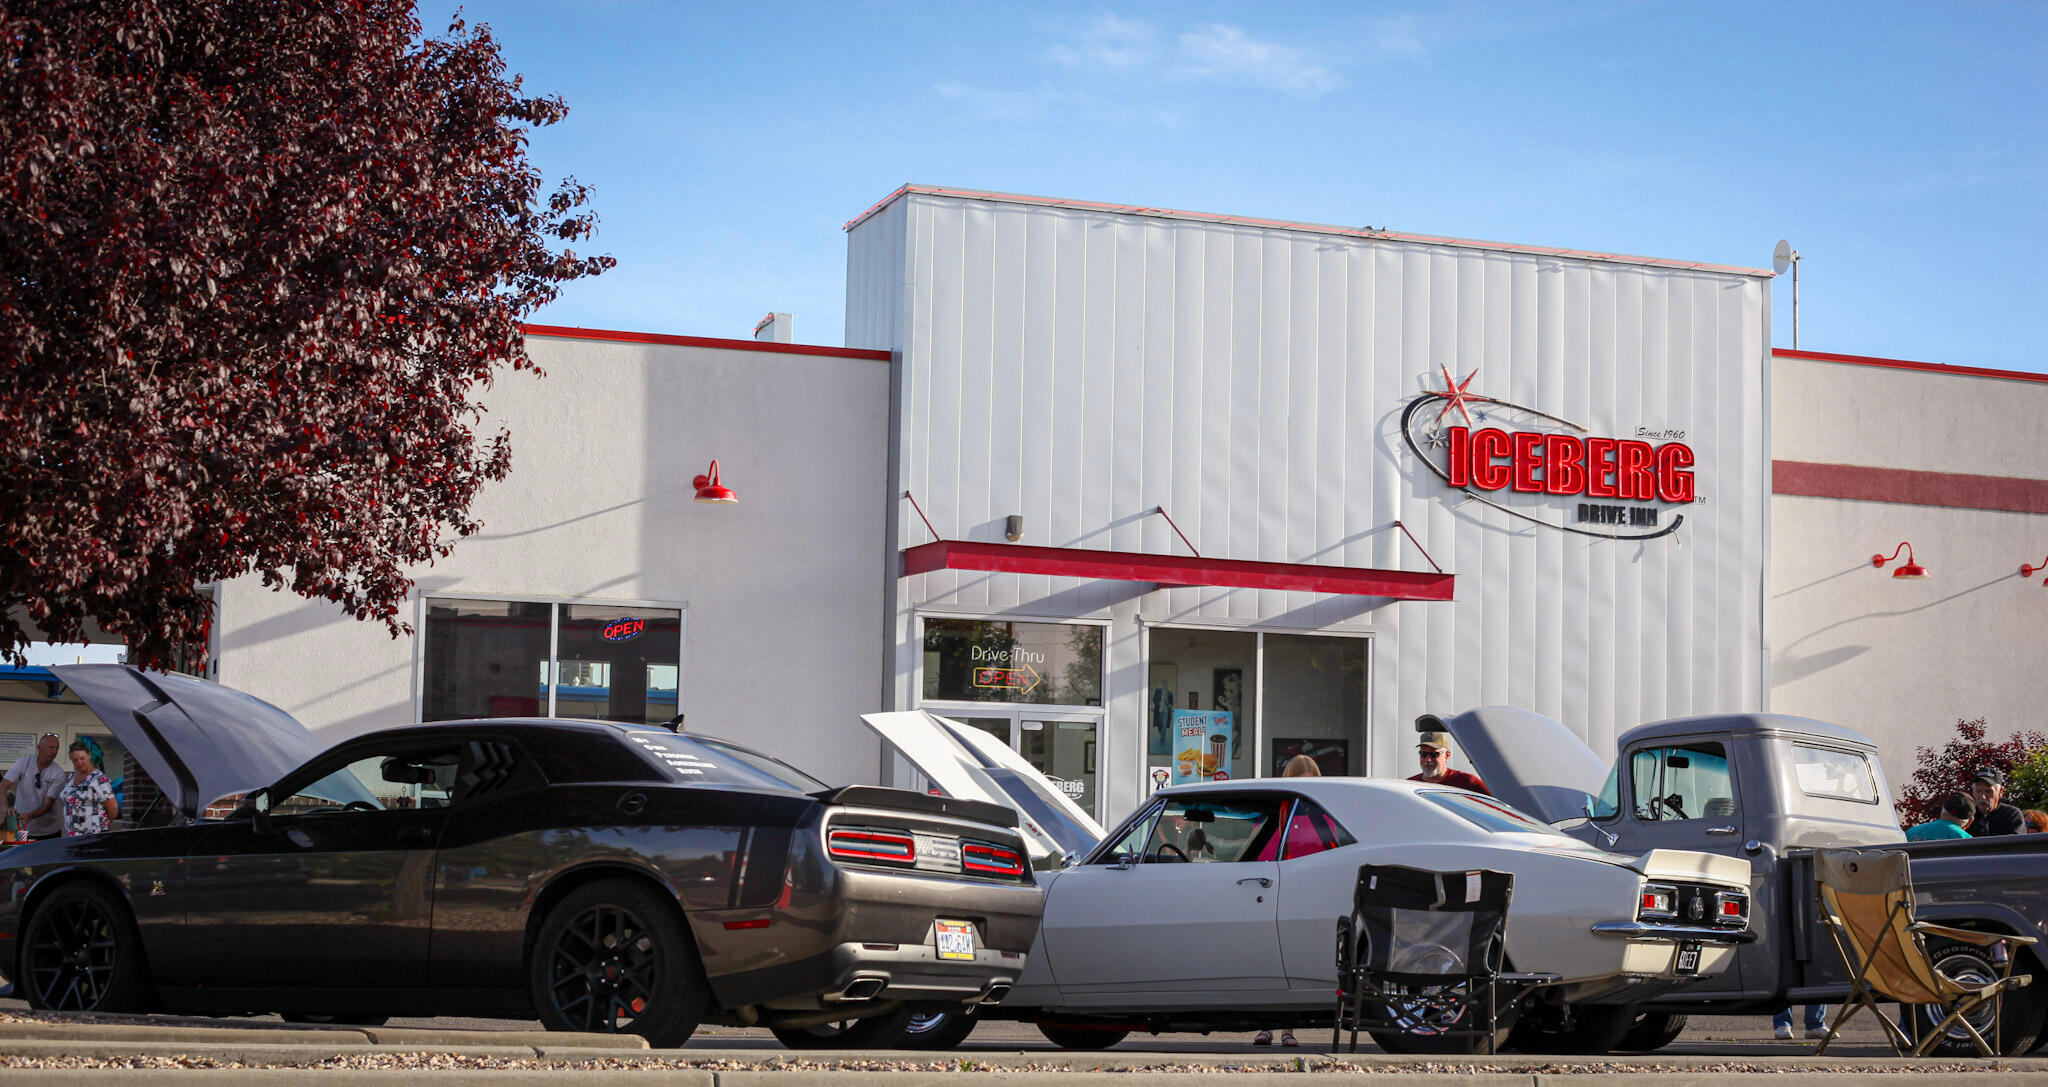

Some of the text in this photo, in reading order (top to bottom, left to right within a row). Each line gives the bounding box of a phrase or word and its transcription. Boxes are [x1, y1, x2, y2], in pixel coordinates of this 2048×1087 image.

[1637, 427, 1686, 439] Since 1960
[1448, 426, 1695, 503] ICEBERG
[1577, 503, 1657, 526] DRIVE INN
[604, 619, 645, 639] OPEN
[979, 670, 1030, 686] OPEN
[1177, 715, 1208, 727] STUDENT
